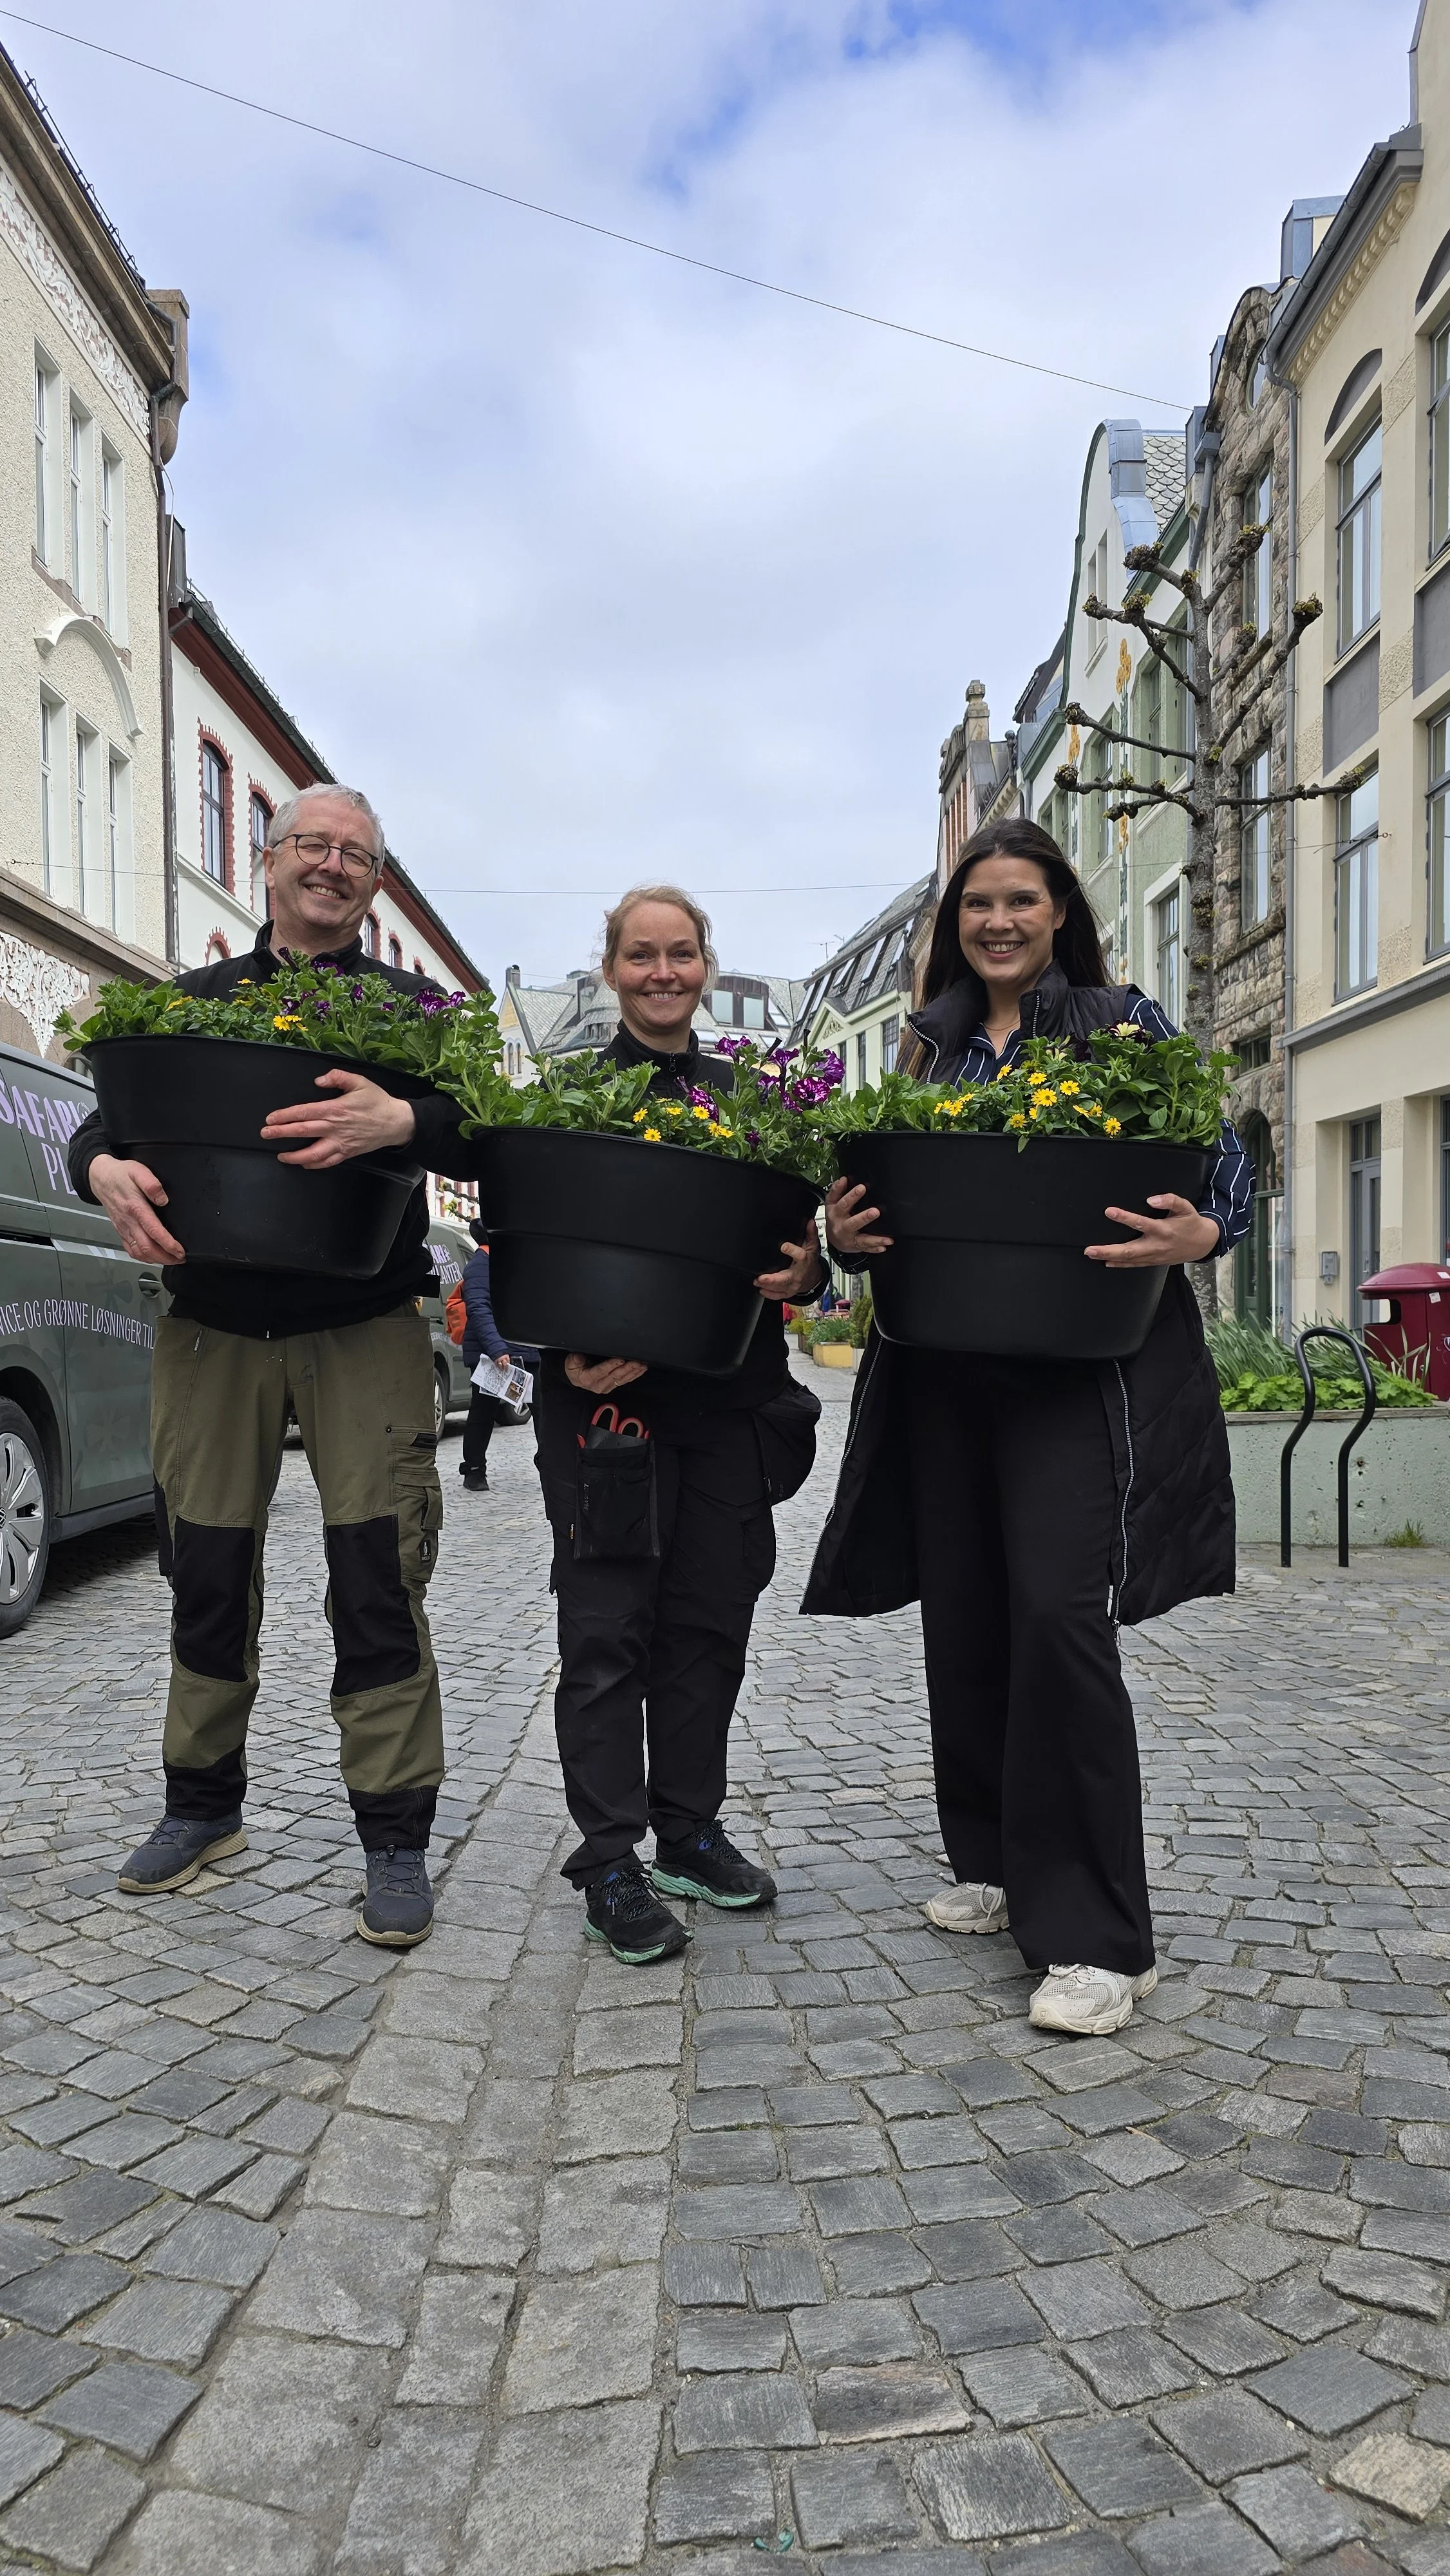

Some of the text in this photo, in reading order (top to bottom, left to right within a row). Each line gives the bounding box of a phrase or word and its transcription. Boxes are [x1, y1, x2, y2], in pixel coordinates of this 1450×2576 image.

[422, 1244, 447, 1264] ARI
[24, 1300, 42, 1329] OG
[44, 1298, 88, 1329] GRØNNE
[91, 1305, 141, 1345] LØSNINGER
[143, 1323, 154, 1349] TIL
